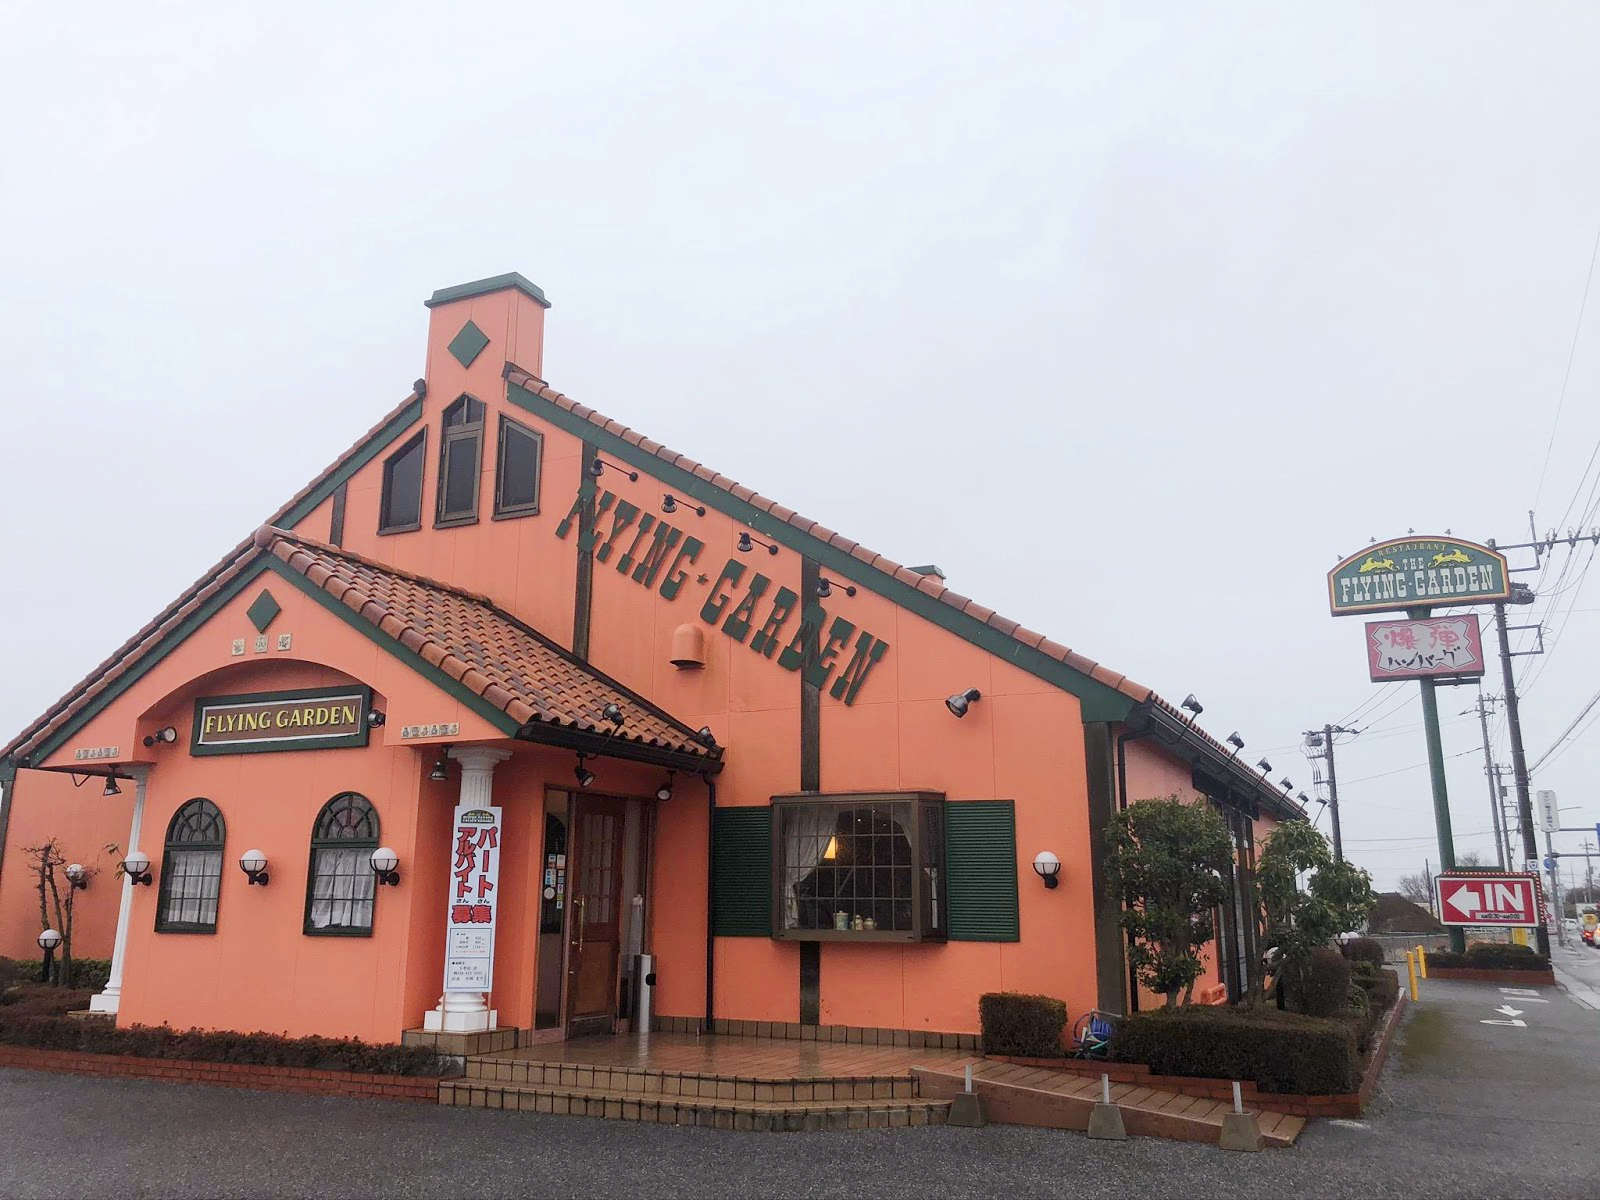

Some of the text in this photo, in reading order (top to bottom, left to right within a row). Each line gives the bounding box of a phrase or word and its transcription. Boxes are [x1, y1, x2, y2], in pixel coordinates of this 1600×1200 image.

[1402, 557, 1425, 570] THE
[555, 479, 889, 706] FLYING GARDEN
[1340, 564, 1494, 603] FLYING GARDEN
[1384, 625, 1460, 650] 爆弾
[1387, 646, 1461, 668] ハンバーグ
[204, 705, 357, 733] FLYING GARDEN
[454, 826, 477, 898] アルバイト
[476, 826, 498, 898] パート
[1483, 883, 1525, 911] IN
[451, 904, 492, 924] 募集
